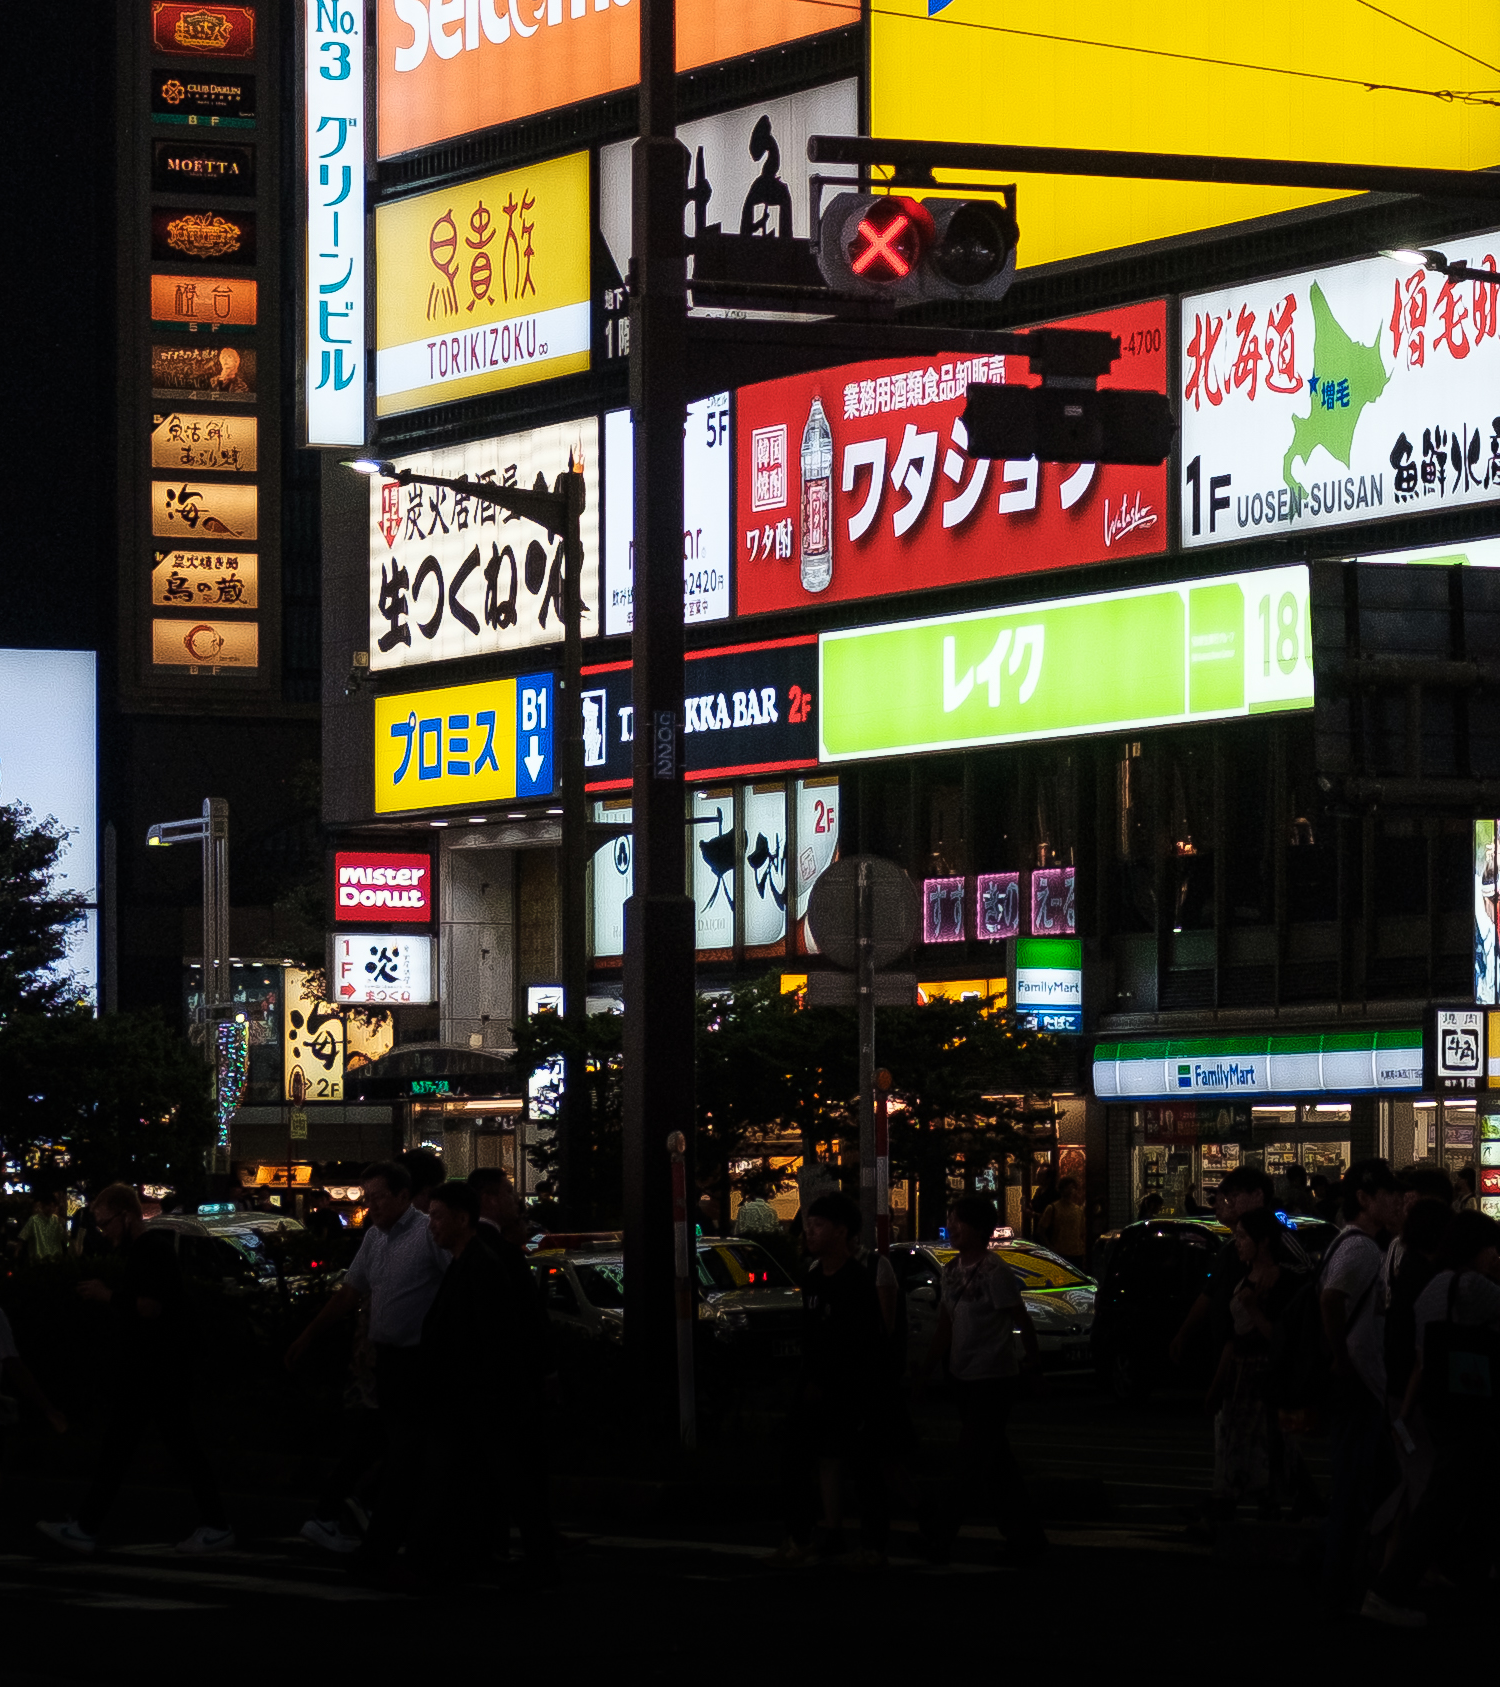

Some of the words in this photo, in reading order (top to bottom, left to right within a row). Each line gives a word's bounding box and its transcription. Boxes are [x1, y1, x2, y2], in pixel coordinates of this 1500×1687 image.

[167, 158, 240, 175] MOETTA
[314, 110, 359, 394] グリーンビル
[427, 319, 536, 380] TORIKIZOKU
[1185, 292, 1304, 412] 北海道
[1321, 377, 1351, 411] 増毛
[706, 409, 729, 448] 5F
[166, 483, 210, 529] 海
[1187, 454, 1232, 536] 1F
[1236, 472, 1384, 529] UOSEN-SUISAN
[745, 517, 793, 562] ワタ酎
[377, 541, 518, 653] 生つくね
[942, 623, 1046, 714] レイク
[522, 687, 548, 733] B1
[732, 687, 779, 728] BAR
[788, 684, 812, 724] 2F
[390, 711, 499, 786] プロミス
[814, 799, 836, 835] 2F
[338, 887, 426, 909] Donut
[1017, 978, 1081, 998] FamilyMart
[316, 1078, 340, 1099] 2F
[1193, 1062, 1257, 1091] FamilyMart
